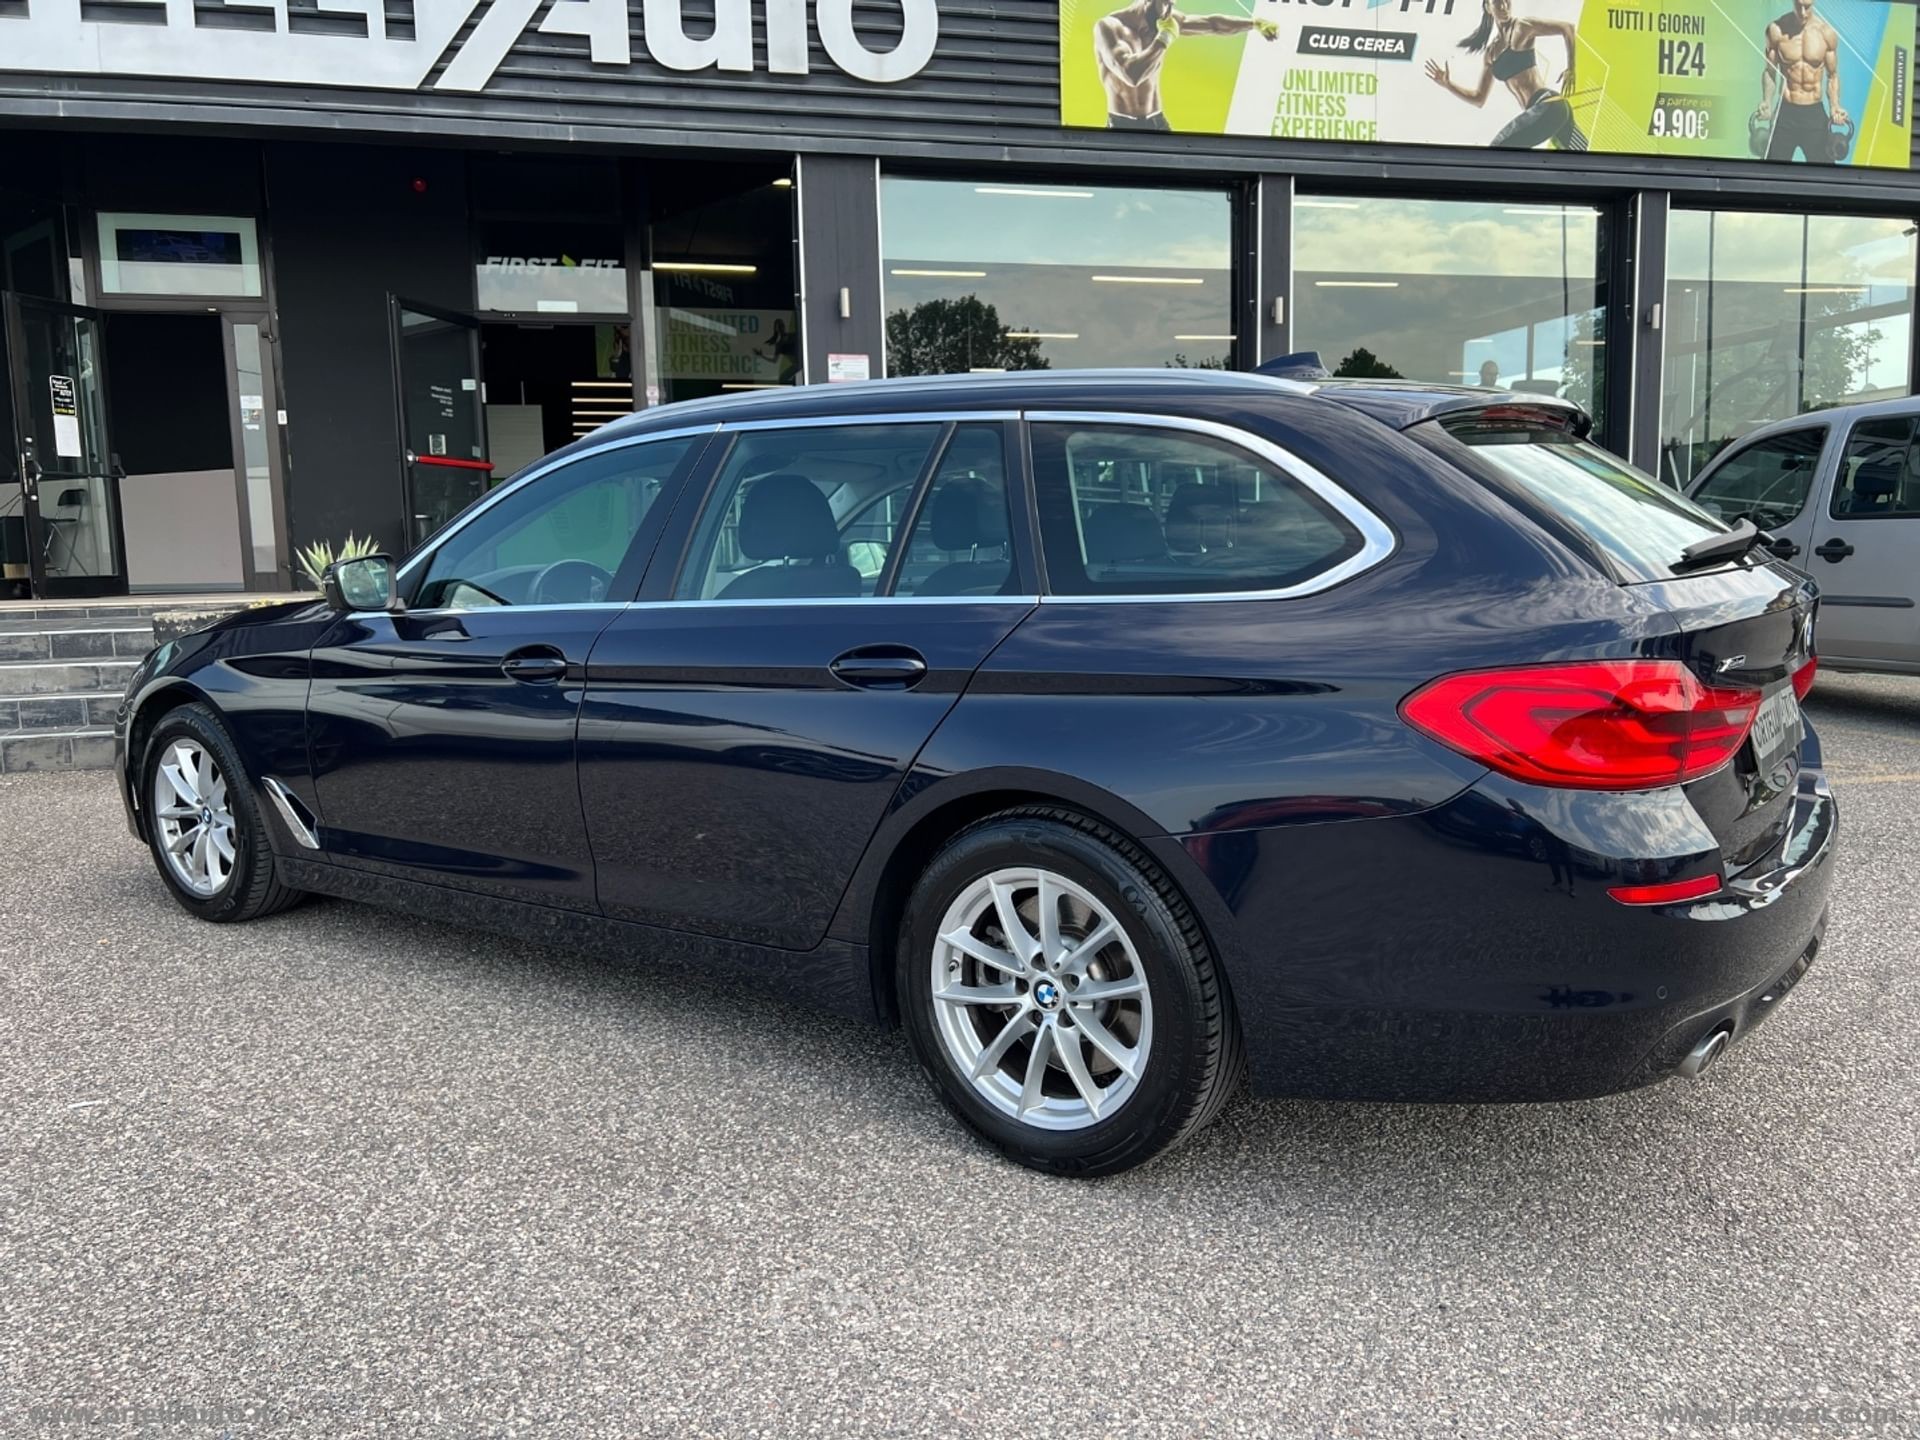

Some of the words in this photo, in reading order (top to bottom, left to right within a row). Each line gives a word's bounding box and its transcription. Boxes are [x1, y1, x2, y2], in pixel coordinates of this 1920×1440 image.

[1607, 8, 1643, 32] TUTTI
[1648, 12, 1653, 32] I
[1657, 12, 1705, 36] GIORNI
[1308, 33, 1350, 50] CLUB
[1353, 36, 1406, 54] CEREA
[1658, 38, 1706, 77] H24
[1283, 68, 1378, 96] UNLIMITED
[1276, 92, 1347, 118] FITNESS
[1658, 97, 1665, 106] a
[1667, 96, 1697, 108] partire
[1699, 98, 1713, 108] da
[1270, 115, 1377, 142] EXPERIENCE
[1652, 107, 1710, 140] 9.90€
[486, 256, 558, 276] FIRST
[579, 258, 620, 277] FIT
[668, 313, 760, 334] UNLIMITED
[664, 334, 731, 353] FITNESS
[663, 353, 762, 375] EXPERIENCE
